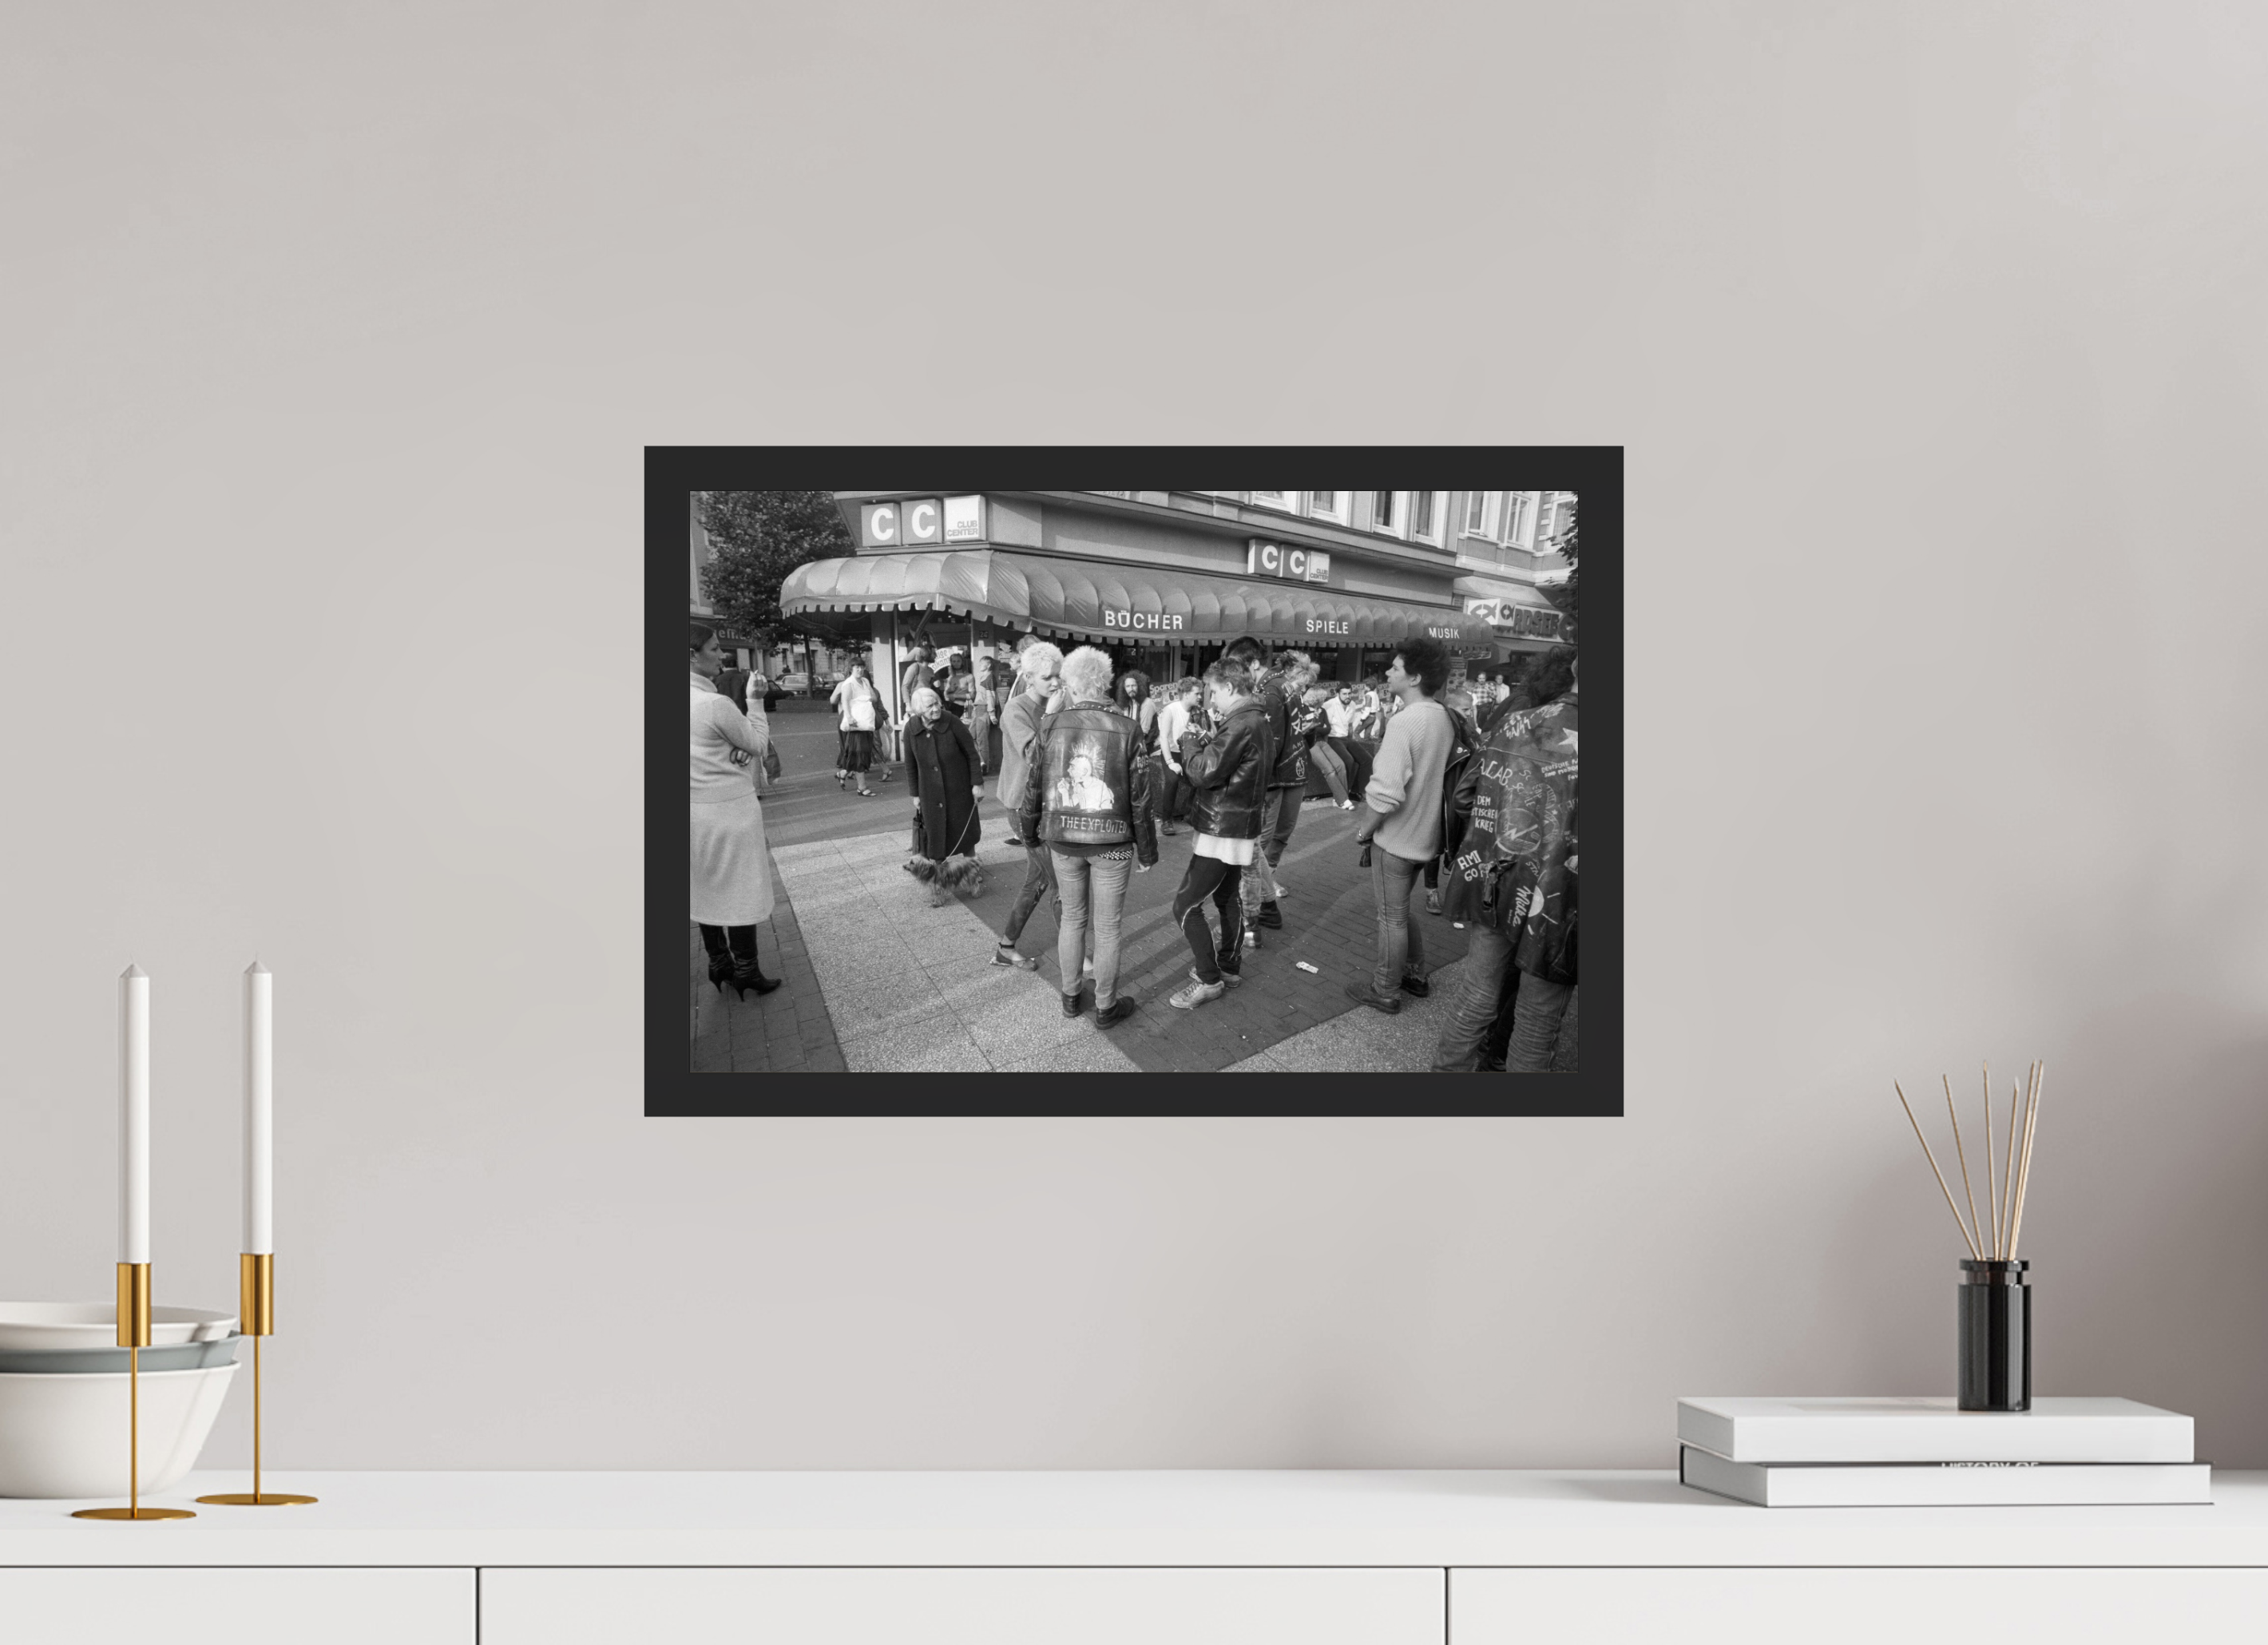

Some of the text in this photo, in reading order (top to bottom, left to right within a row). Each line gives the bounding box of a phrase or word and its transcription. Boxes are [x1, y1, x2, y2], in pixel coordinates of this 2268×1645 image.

[871, 504, 936, 541] C C
[957, 520, 978, 529] CLUB
[946, 528, 979, 537] CENTER
[1261, 545, 1306, 574] C C
[1104, 610, 1183, 630] BÜCHER
[1306, 620, 1349, 635] SPIELE
[1515, 608, 1560, 636] RDSEE
[1428, 627, 1460, 640] MUSIK
[1148, 682, 1178, 695] Sparen
[1477, 795, 1491, 807] DEM
[1471, 807, 1498, 819] STISCHE
[1061, 815, 1078, 830] THE
[1474, 817, 1494, 834] KRIEG
[1457, 850, 1482, 870] AMI
